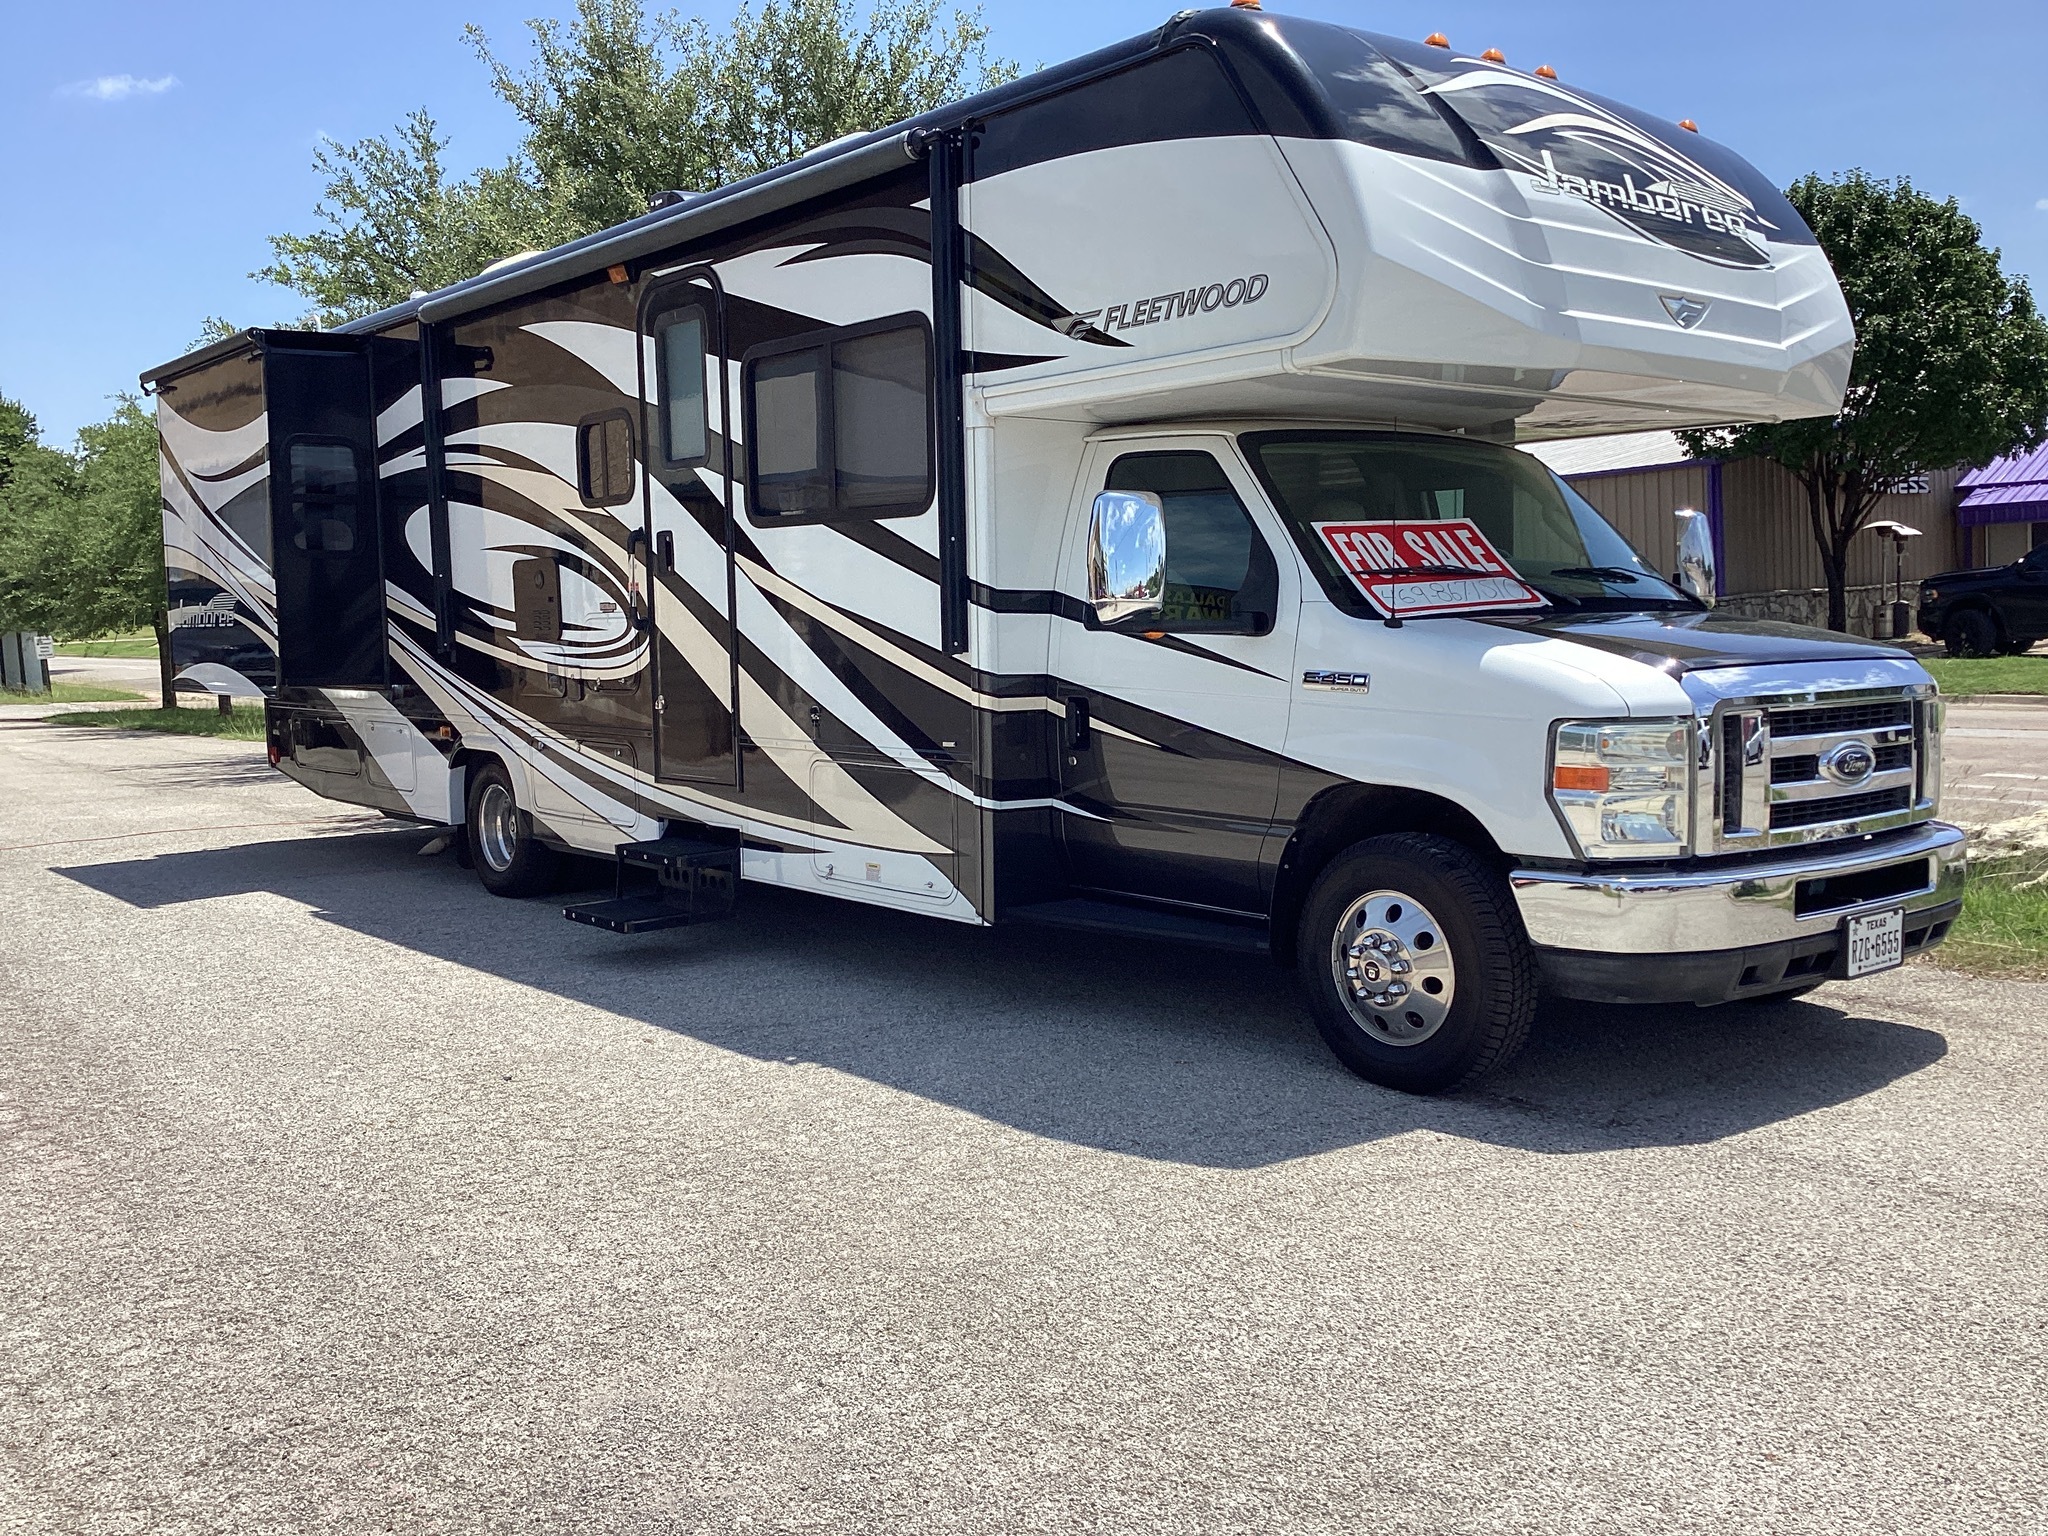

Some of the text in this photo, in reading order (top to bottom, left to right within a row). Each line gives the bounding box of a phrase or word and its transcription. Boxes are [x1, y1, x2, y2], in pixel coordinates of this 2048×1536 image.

[1530, 149, 1748, 239] Jamboree
[1103, 273, 1269, 333] FLEETWOOD
[1331, 528, 1503, 579] FOR SALE
[1866, 917, 1887, 931] TEXAS
